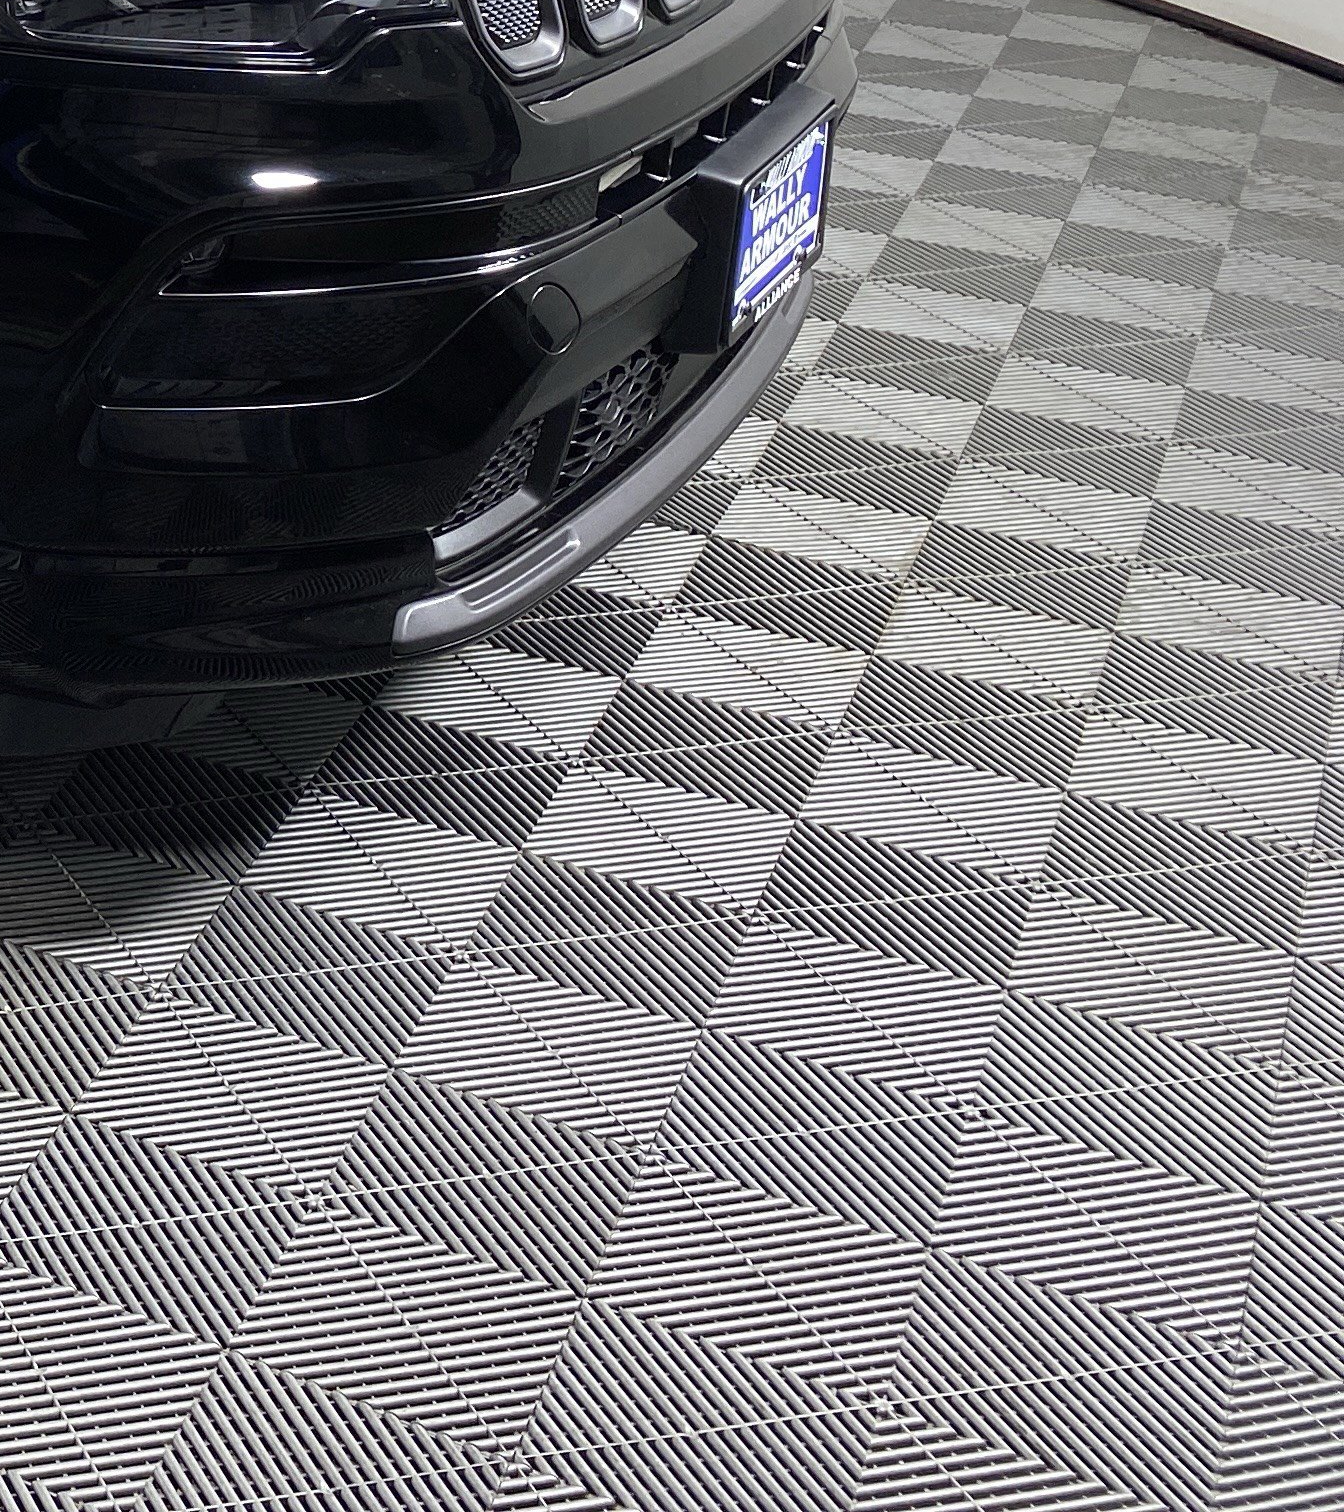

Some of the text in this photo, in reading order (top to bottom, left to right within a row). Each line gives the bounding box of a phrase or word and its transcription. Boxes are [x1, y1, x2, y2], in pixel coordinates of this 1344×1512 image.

[738, 192, 812, 284] ARMOUR
[751, 162, 808, 238] WALLY
[754, 267, 801, 323] ALLIANCE
